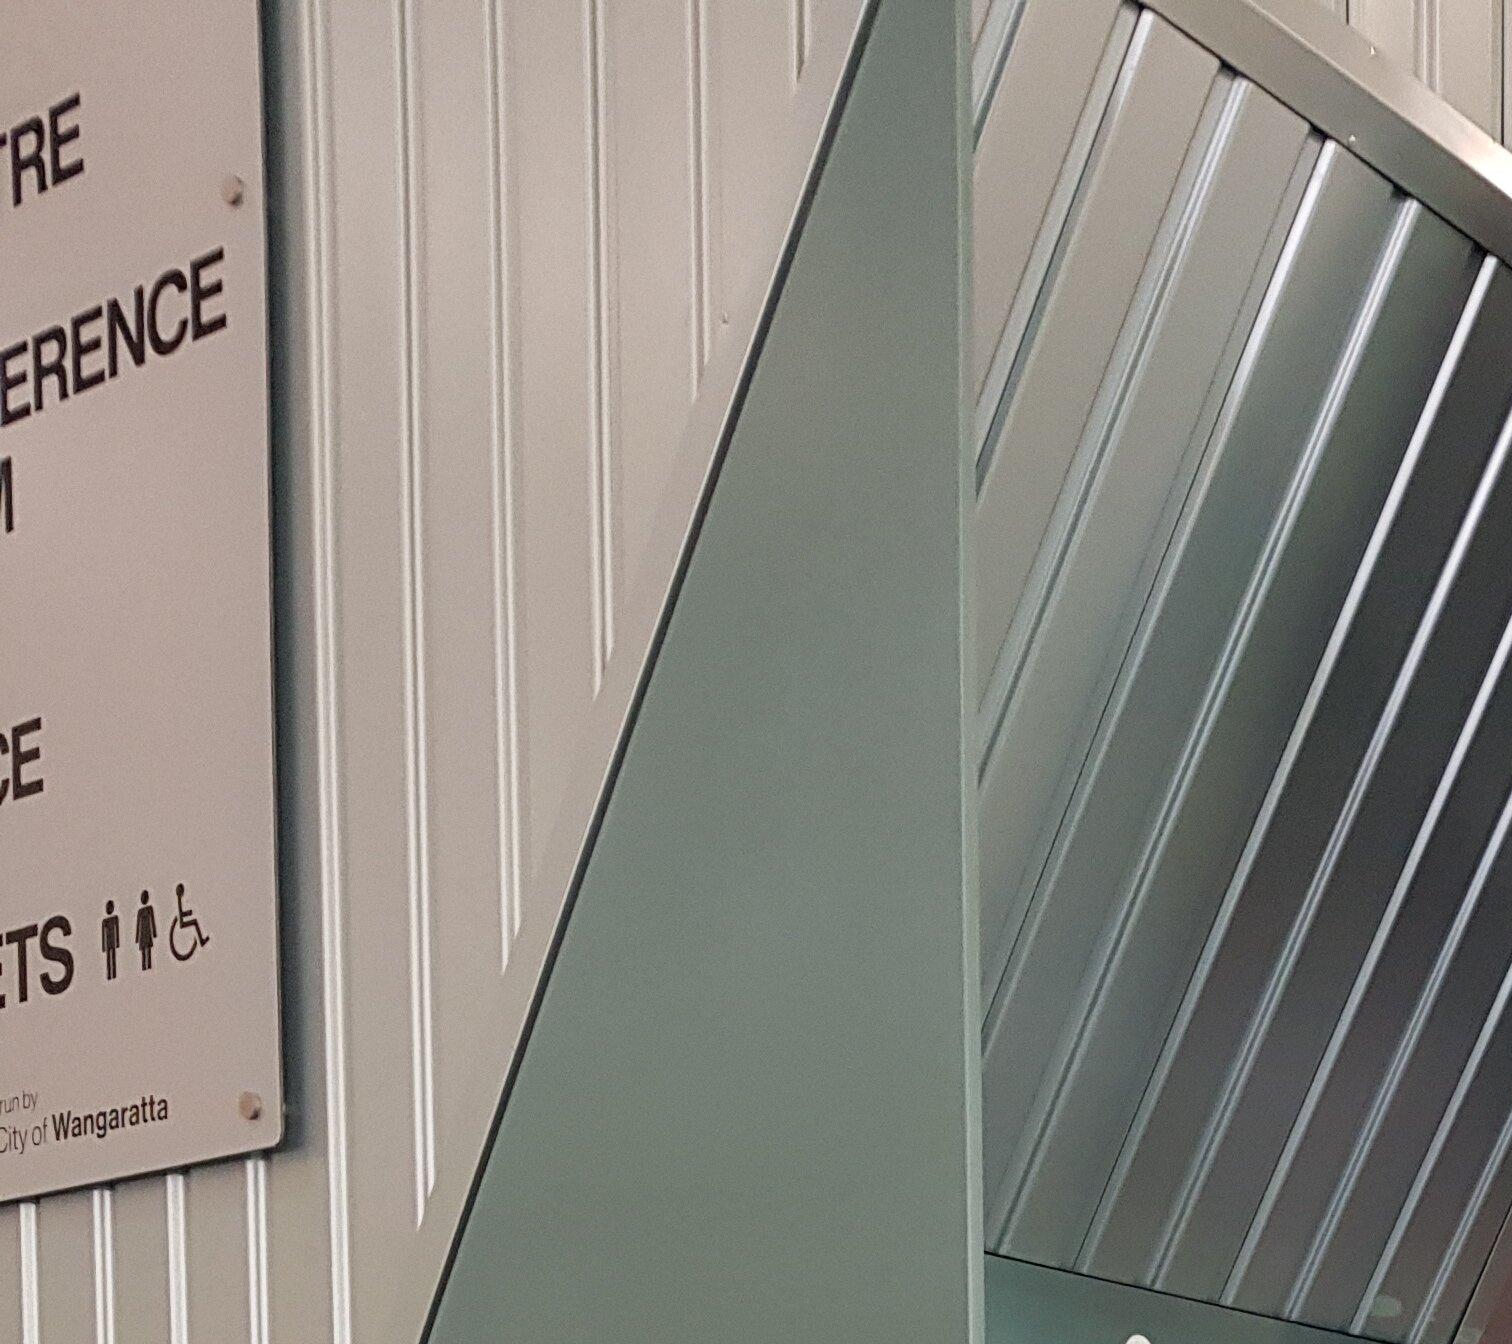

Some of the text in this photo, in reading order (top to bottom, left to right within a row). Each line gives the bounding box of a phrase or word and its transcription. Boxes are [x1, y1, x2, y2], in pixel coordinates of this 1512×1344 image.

[0, 92, 84, 207] RE
[0, 716, 44, 802] E
[0, 915, 75, 1008] TS
[32, 1116, 48, 1147] of
[52, 1094, 169, 1142] Wangaratta
